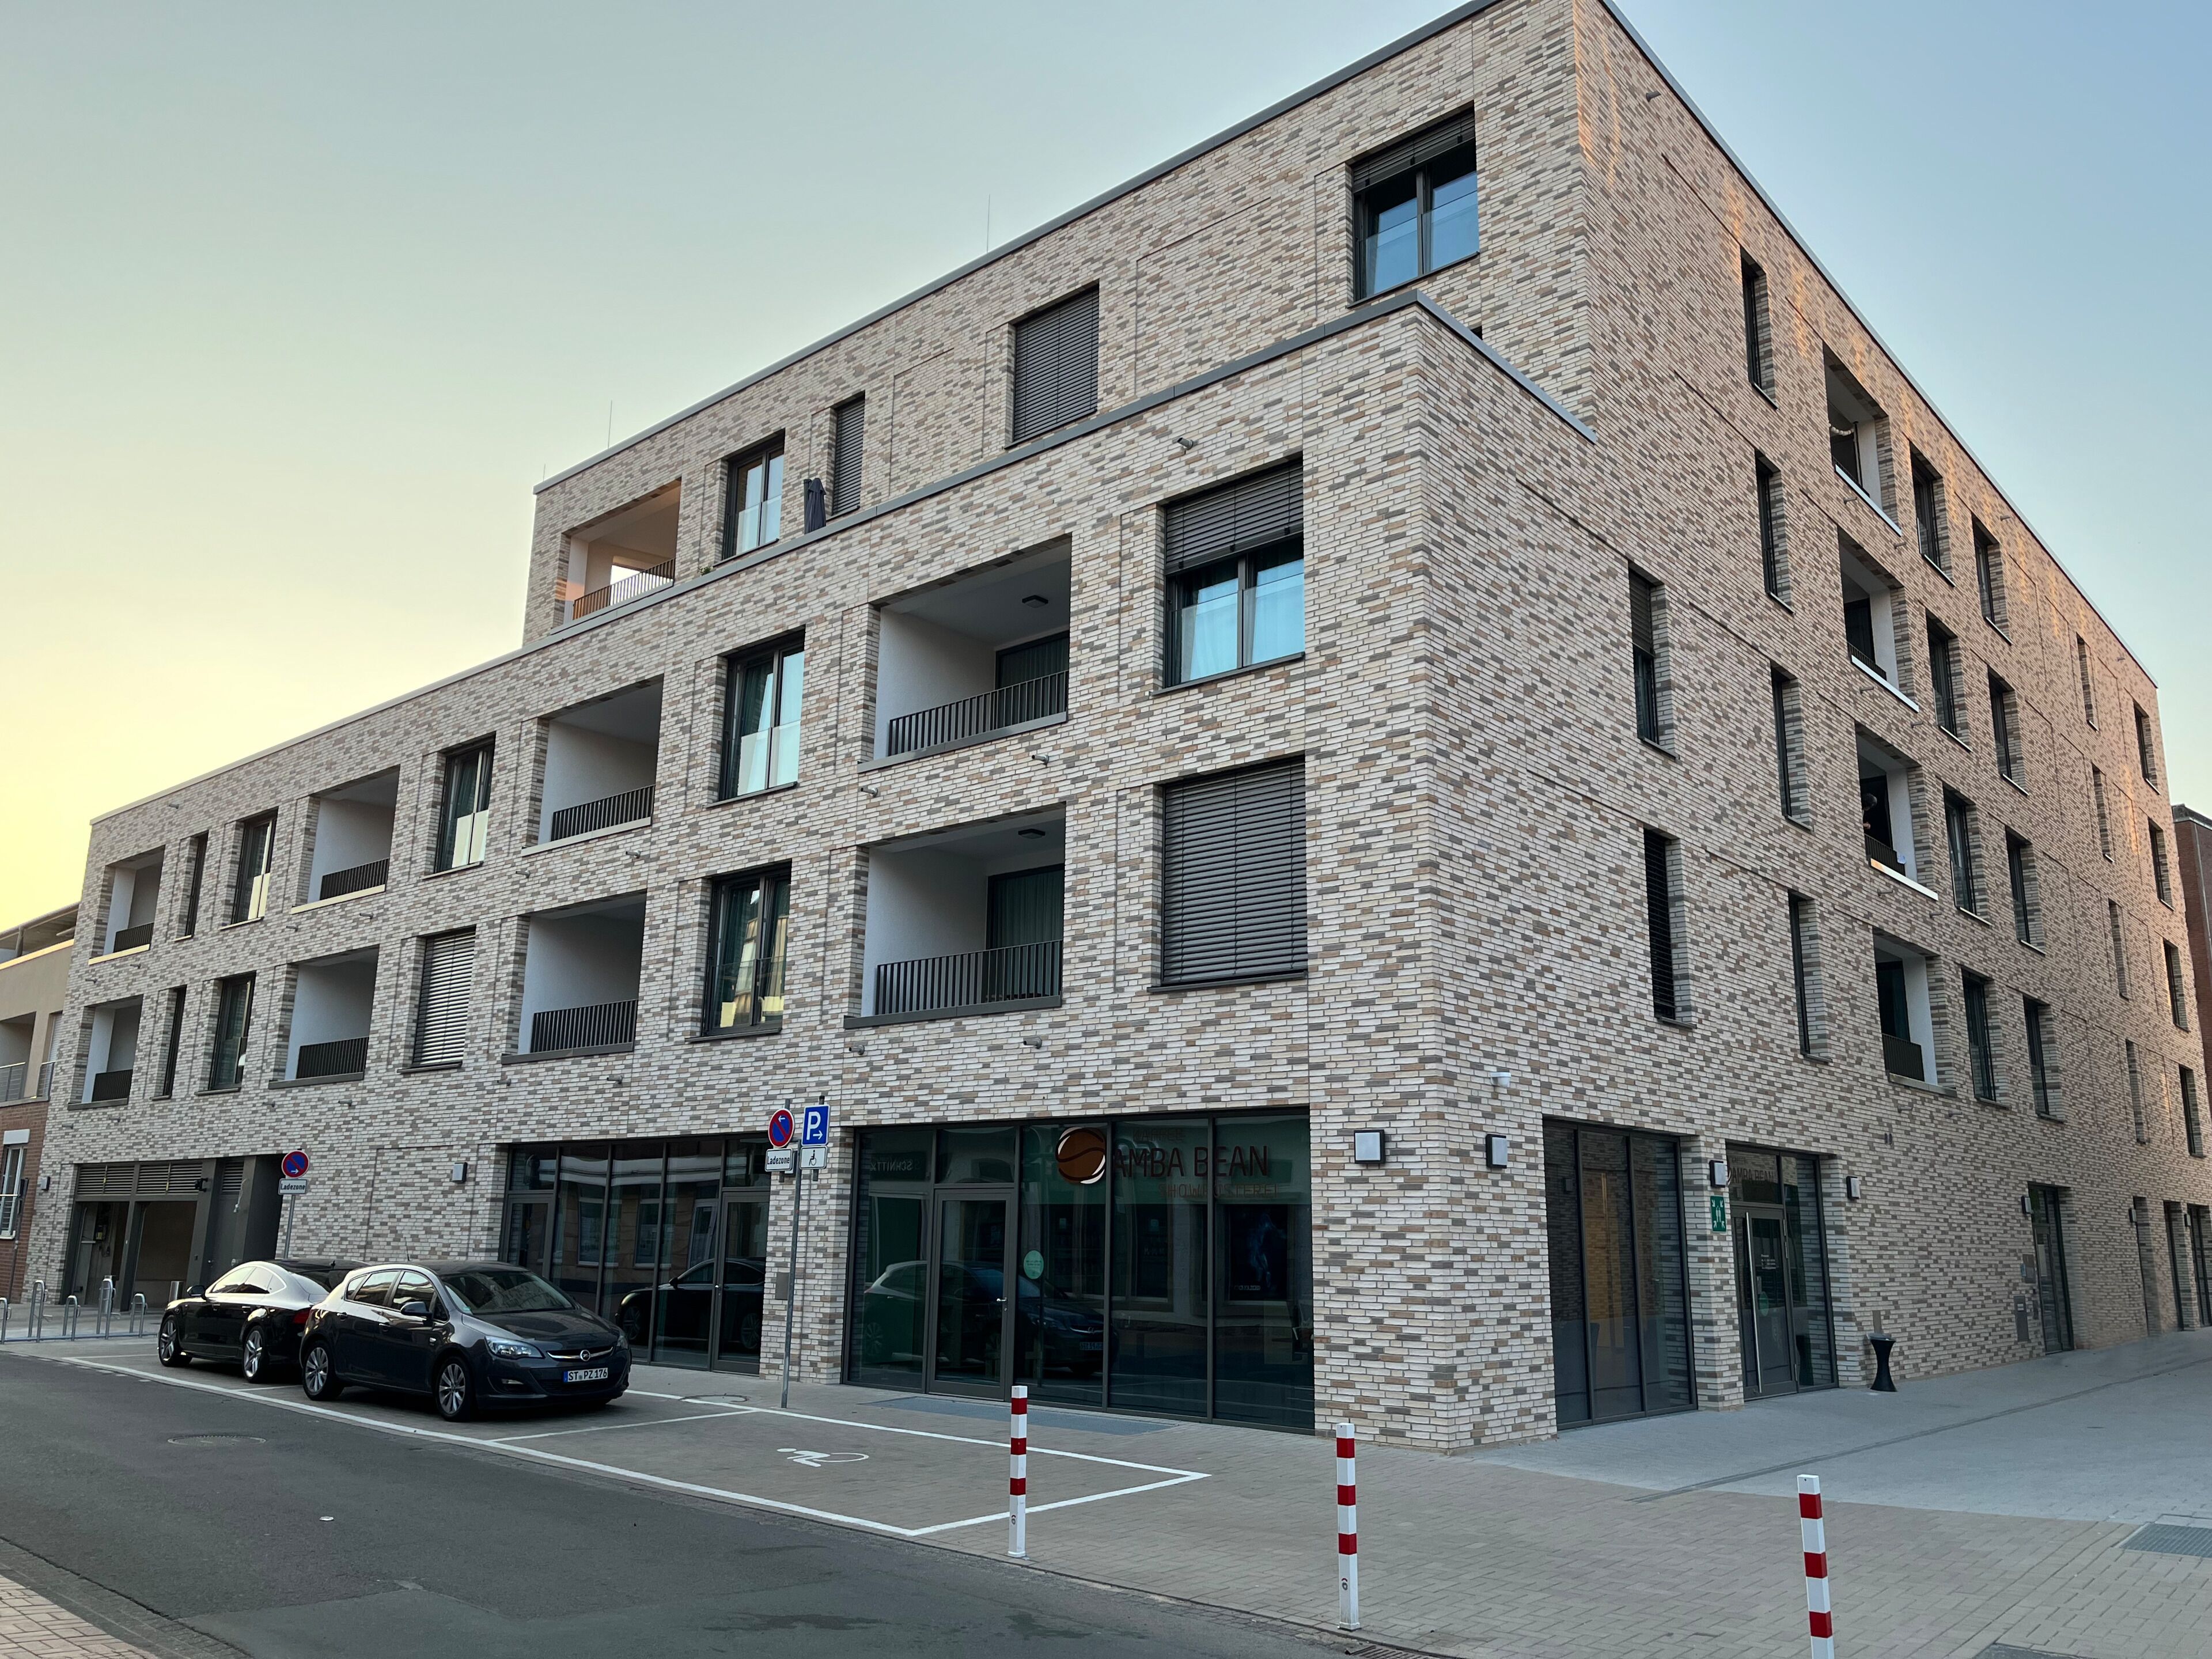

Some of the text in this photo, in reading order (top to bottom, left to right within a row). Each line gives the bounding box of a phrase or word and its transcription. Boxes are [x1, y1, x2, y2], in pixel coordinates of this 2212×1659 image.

[806, 1111, 821, 1141] P
[767, 1156, 790, 1165] Ladezone
[1194, 1145, 1267, 1177] BEAN
[569, 1369, 607, 1381] ST PZ 176
